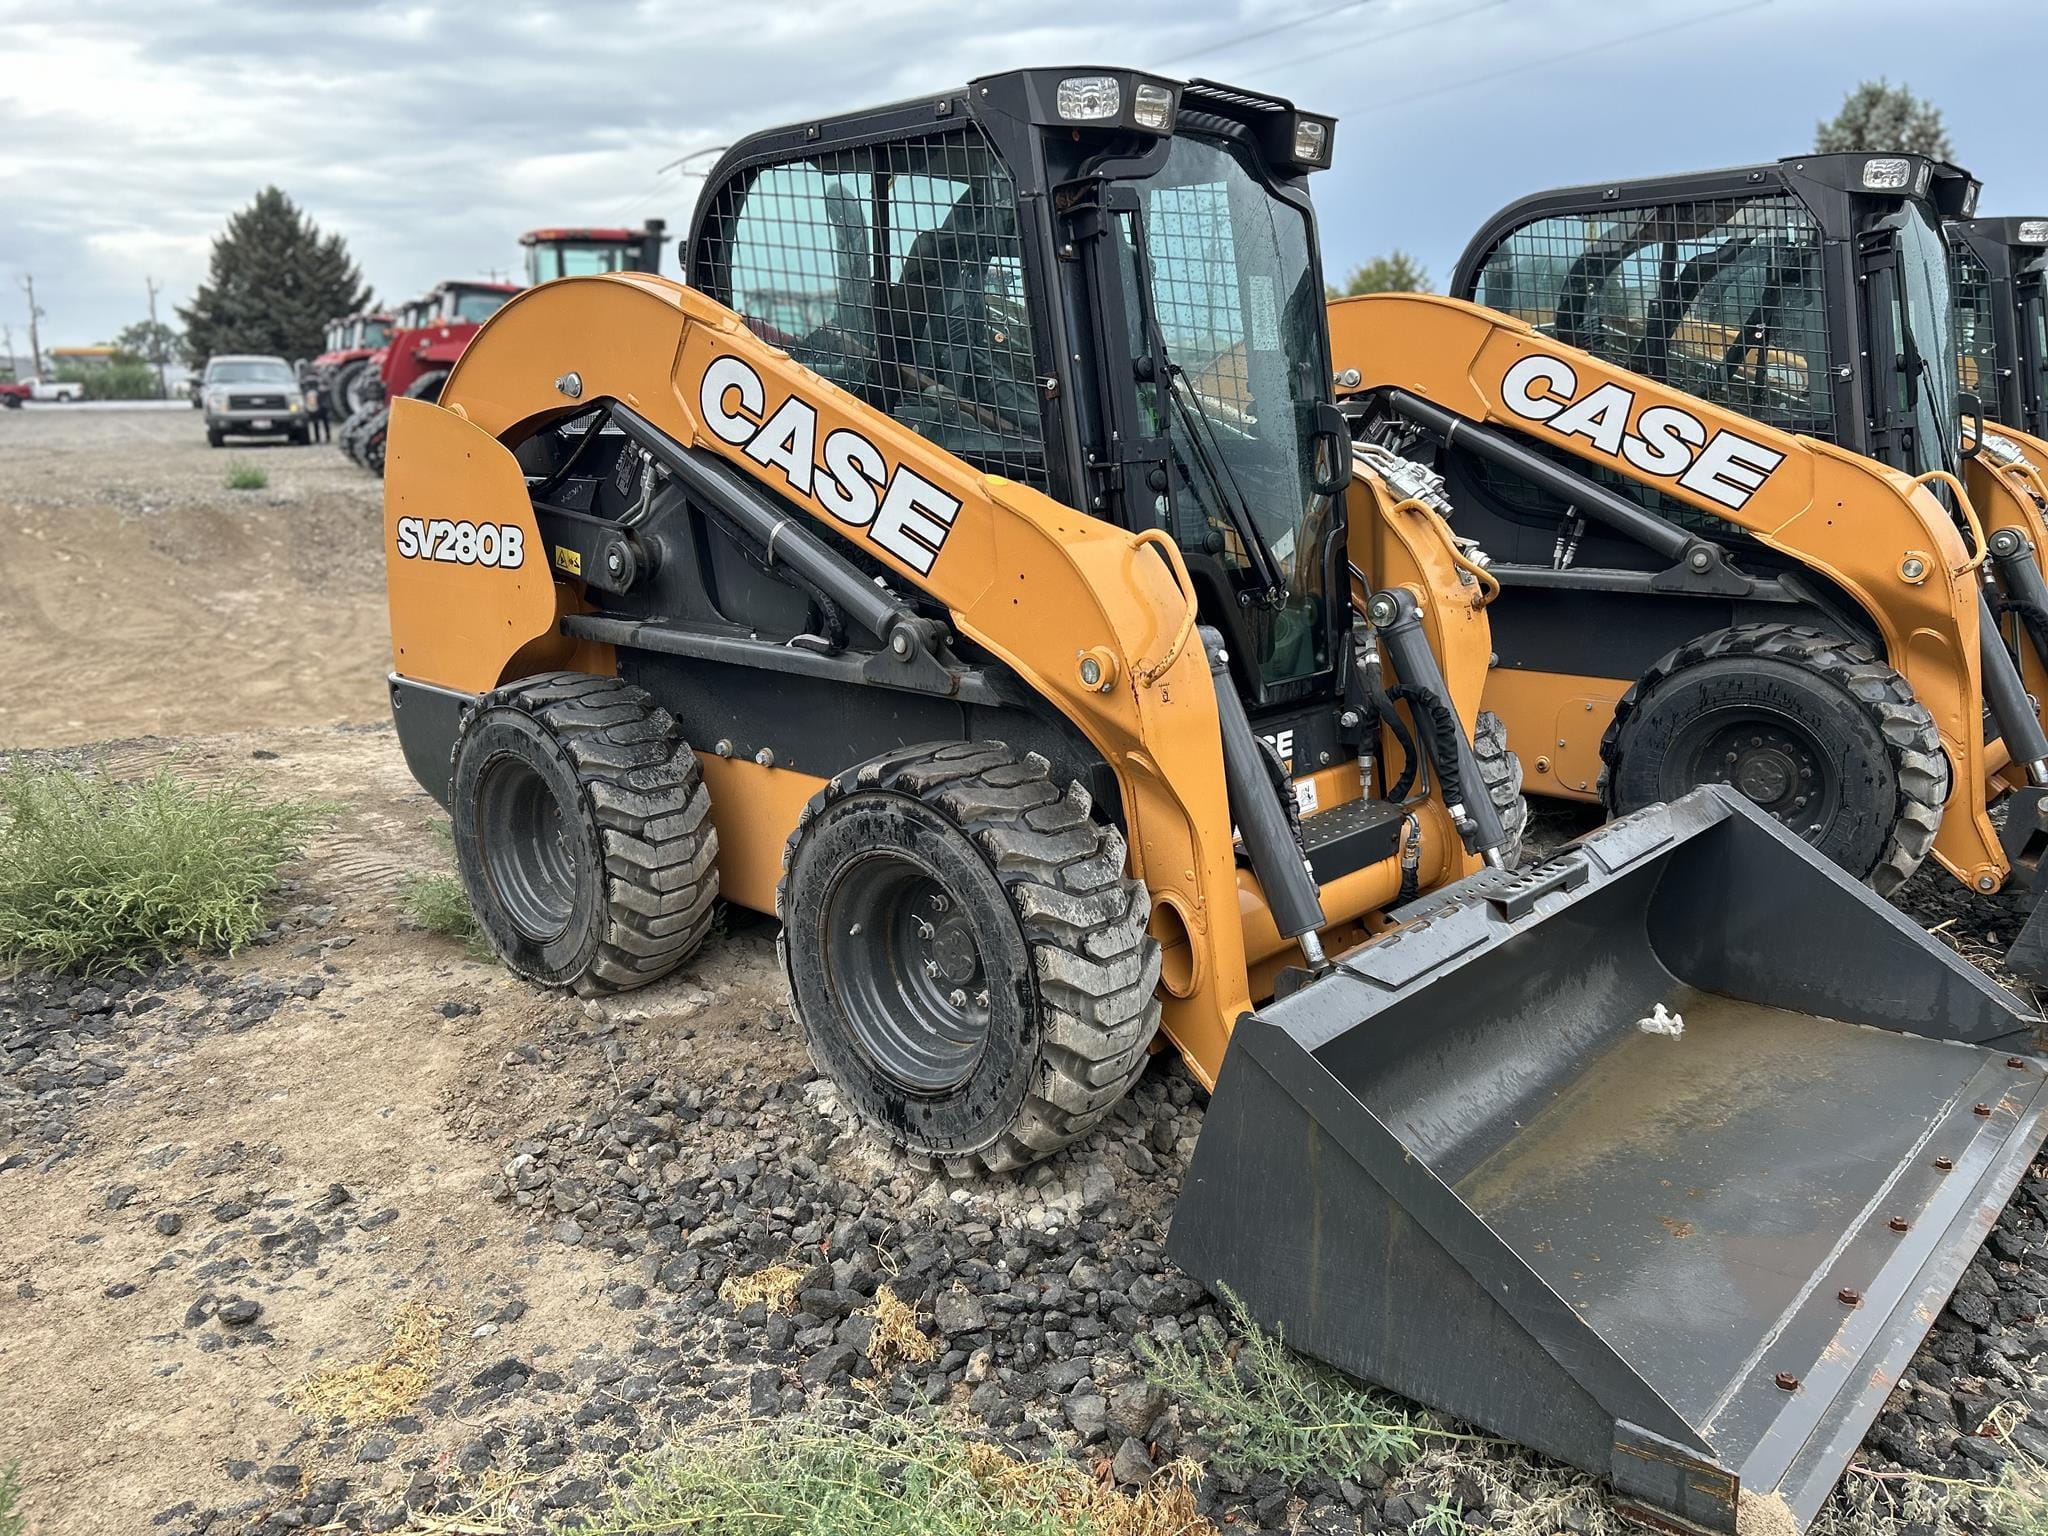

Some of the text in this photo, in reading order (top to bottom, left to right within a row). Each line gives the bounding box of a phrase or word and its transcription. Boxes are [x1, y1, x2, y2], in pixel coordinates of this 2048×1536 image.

[700, 354, 964, 578] CASE
[1501, 354, 1788, 511] CASE
[397, 516, 525, 568] SV280B
